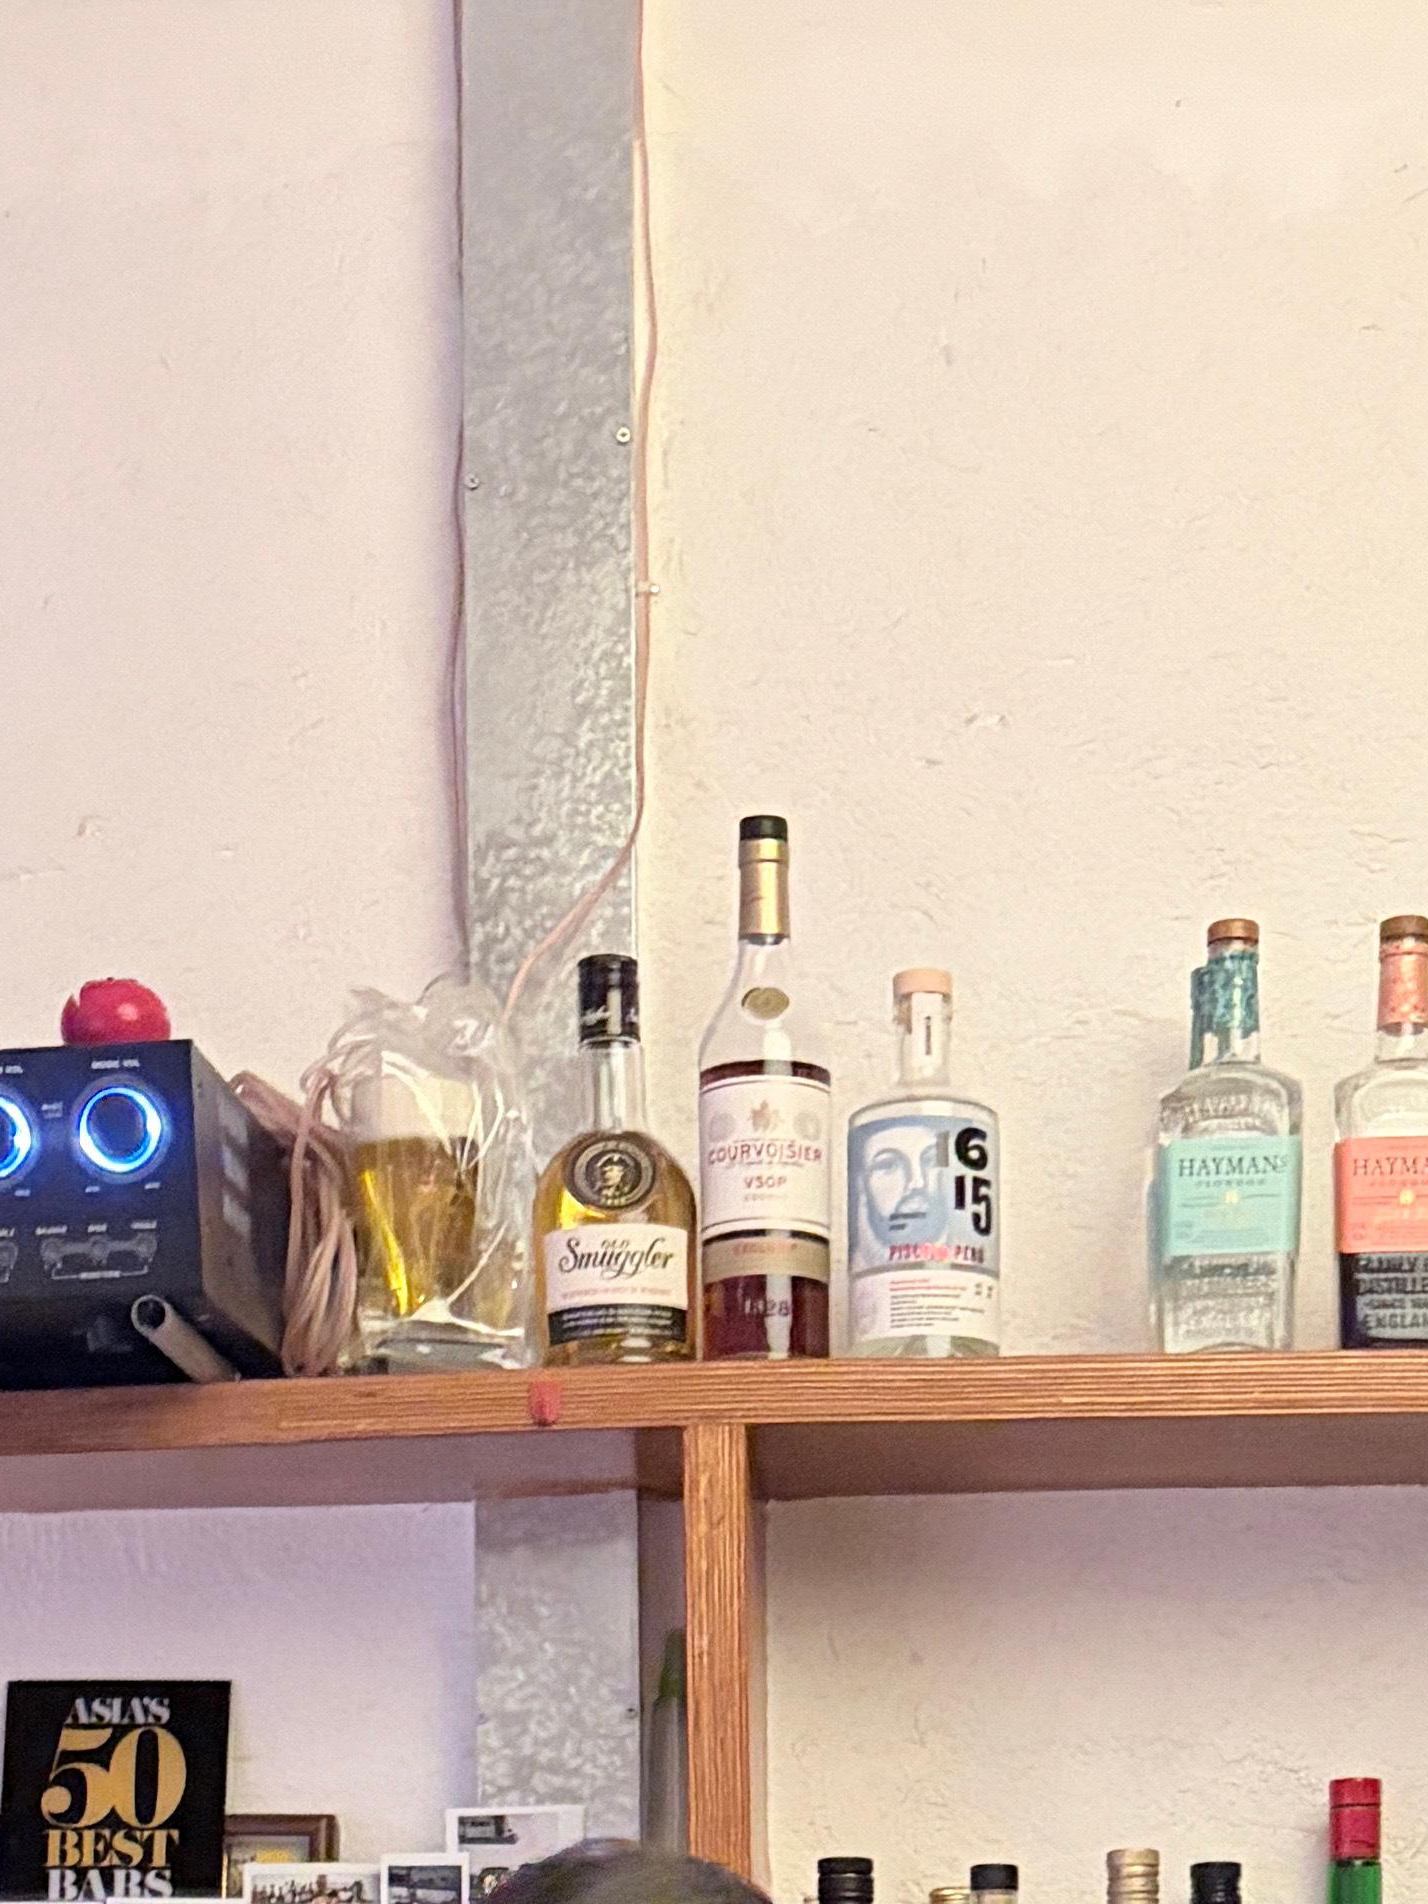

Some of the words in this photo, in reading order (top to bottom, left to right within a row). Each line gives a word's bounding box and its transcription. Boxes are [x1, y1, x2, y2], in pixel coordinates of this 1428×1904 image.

[708, 1141, 823, 1166] COURVOISIER
[742, 1173, 788, 1190] VSOP
[953, 1174, 993, 1237] 15
[558, 1236, 674, 1280] Smuggler
[40, 1725, 188, 1830] 50
[43, 1829, 181, 1868] BEST
[47, 1868, 174, 1901] BARS
